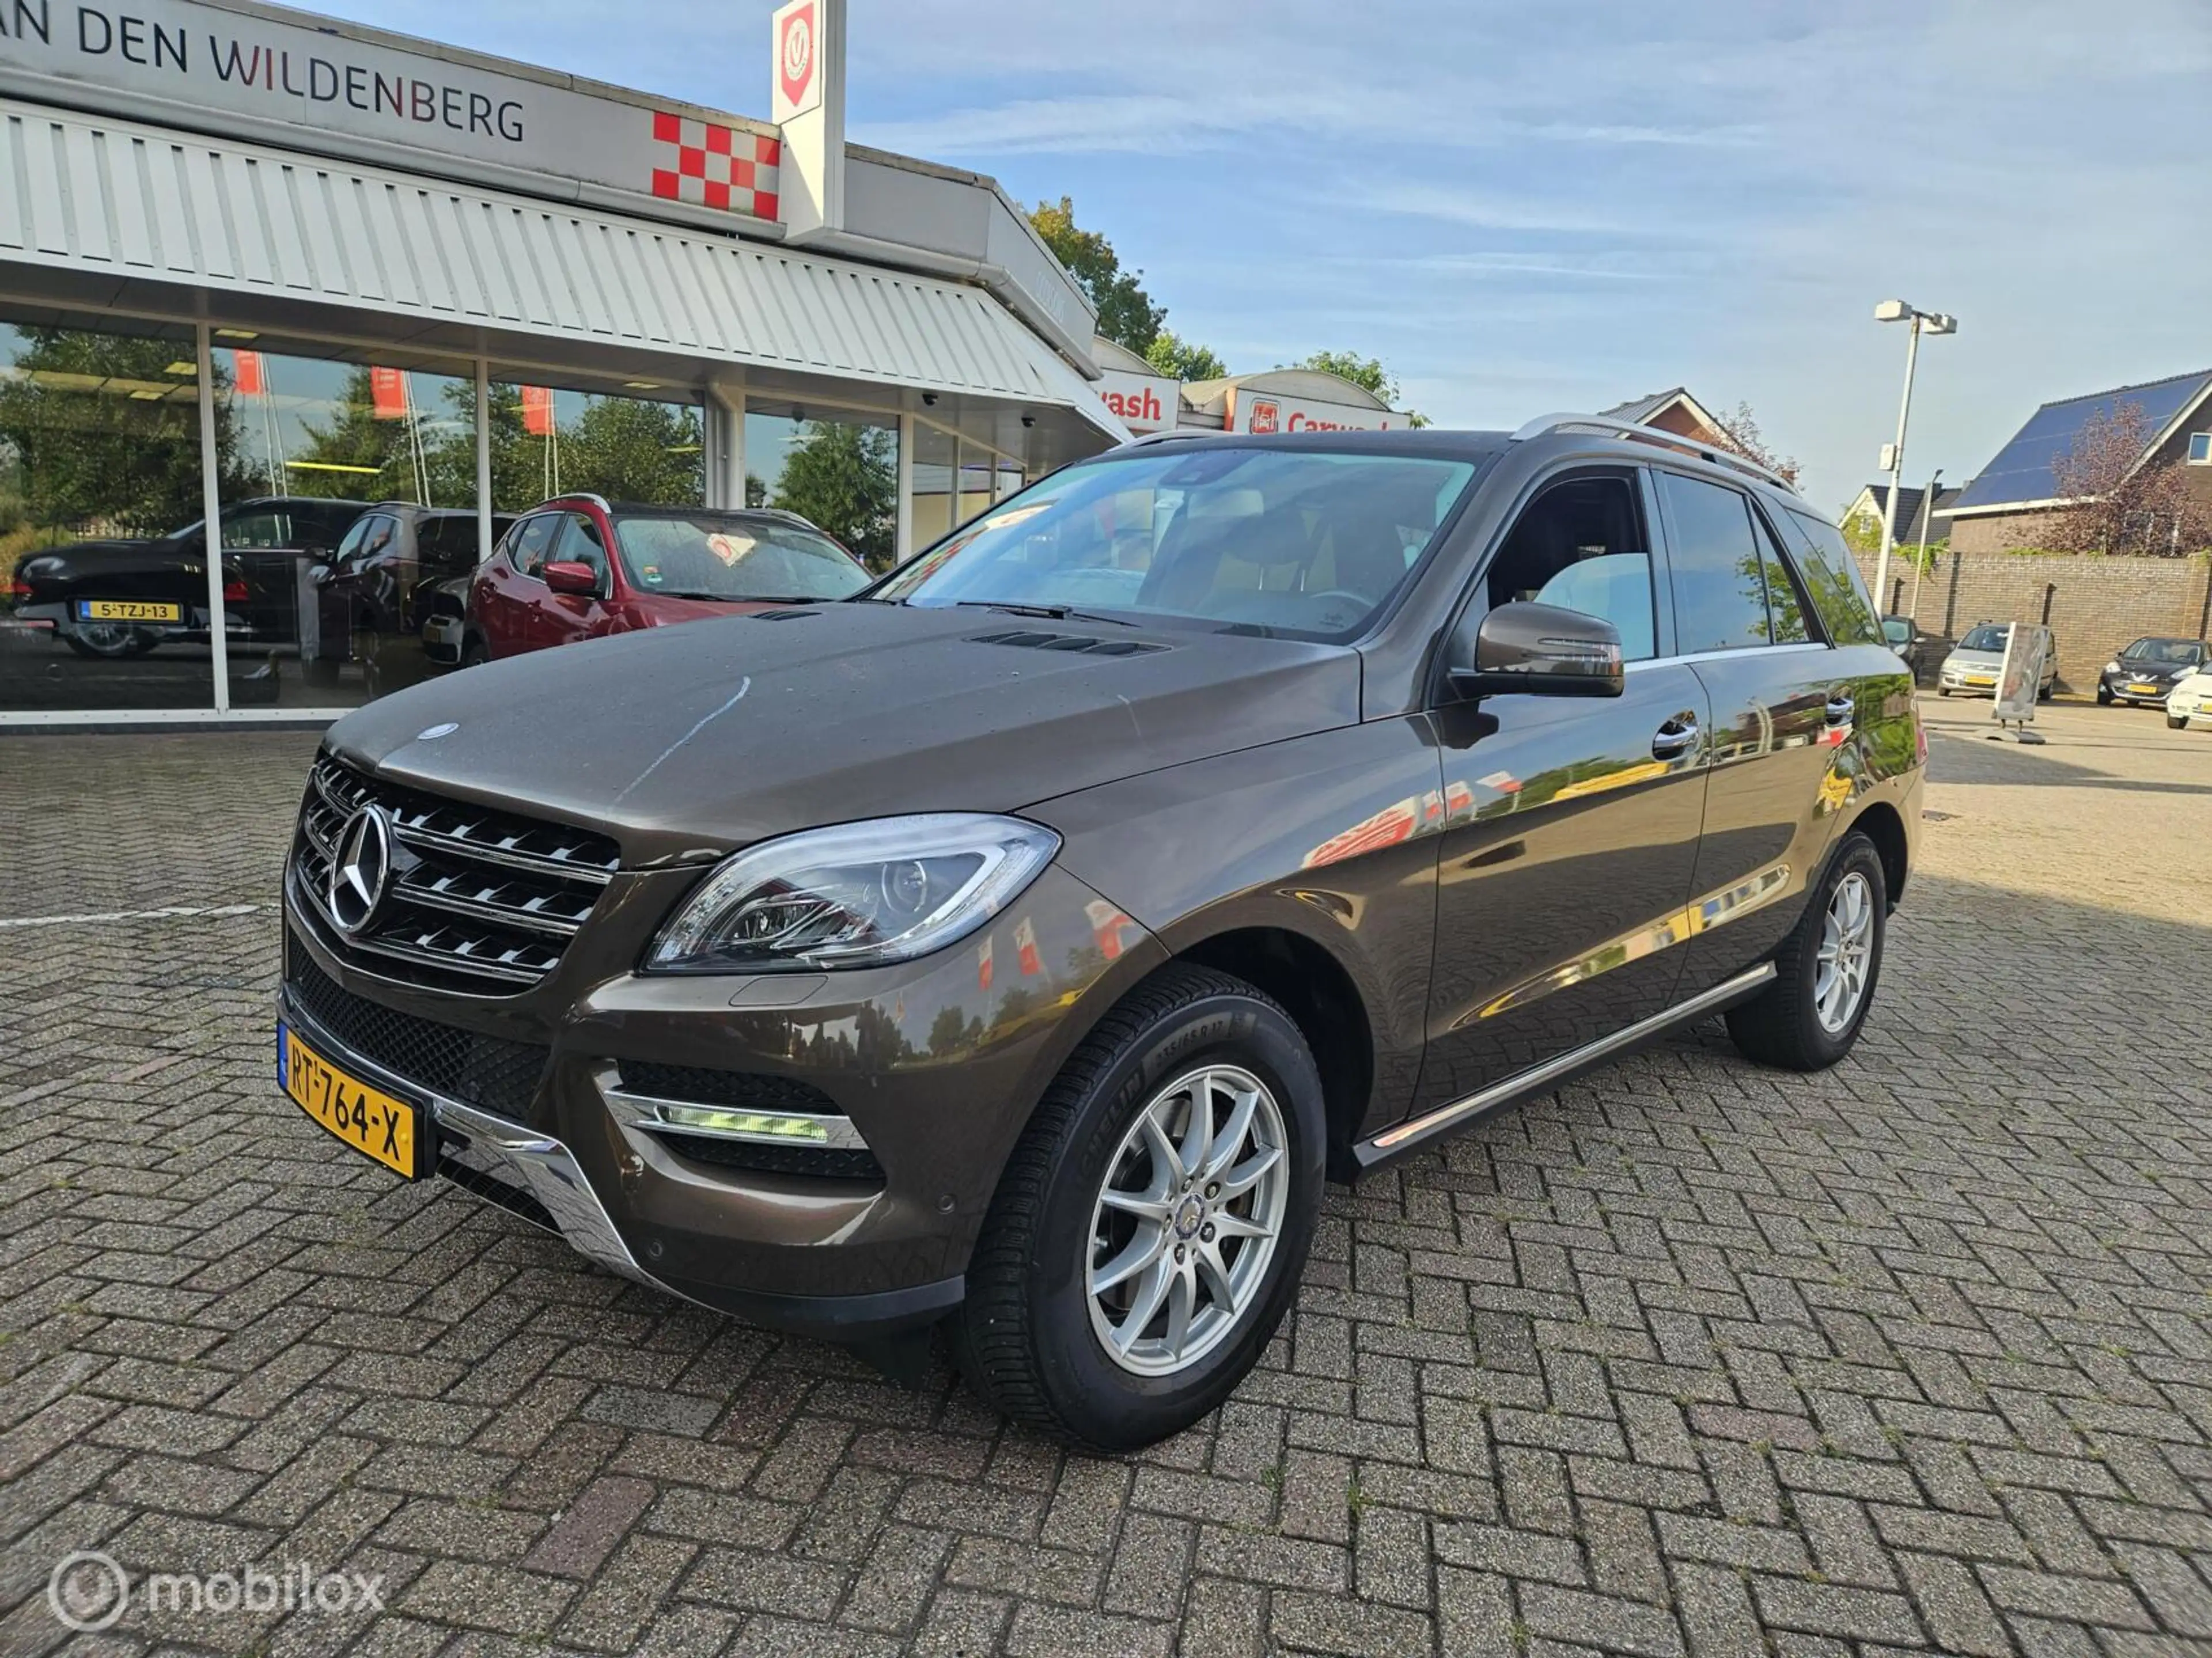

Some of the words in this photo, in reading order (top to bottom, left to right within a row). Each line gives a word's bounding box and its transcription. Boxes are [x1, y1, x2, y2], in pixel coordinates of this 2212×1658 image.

[0, 0, 50, 45] N
[78, 6, 188, 73] DEN
[209, 35, 525, 142] WILDENBERG
[1101, 387, 1161, 421] ash
[101, 604, 168, 619] 5-TZJ-13
[292, 1043, 401, 1162] RT-764-X
